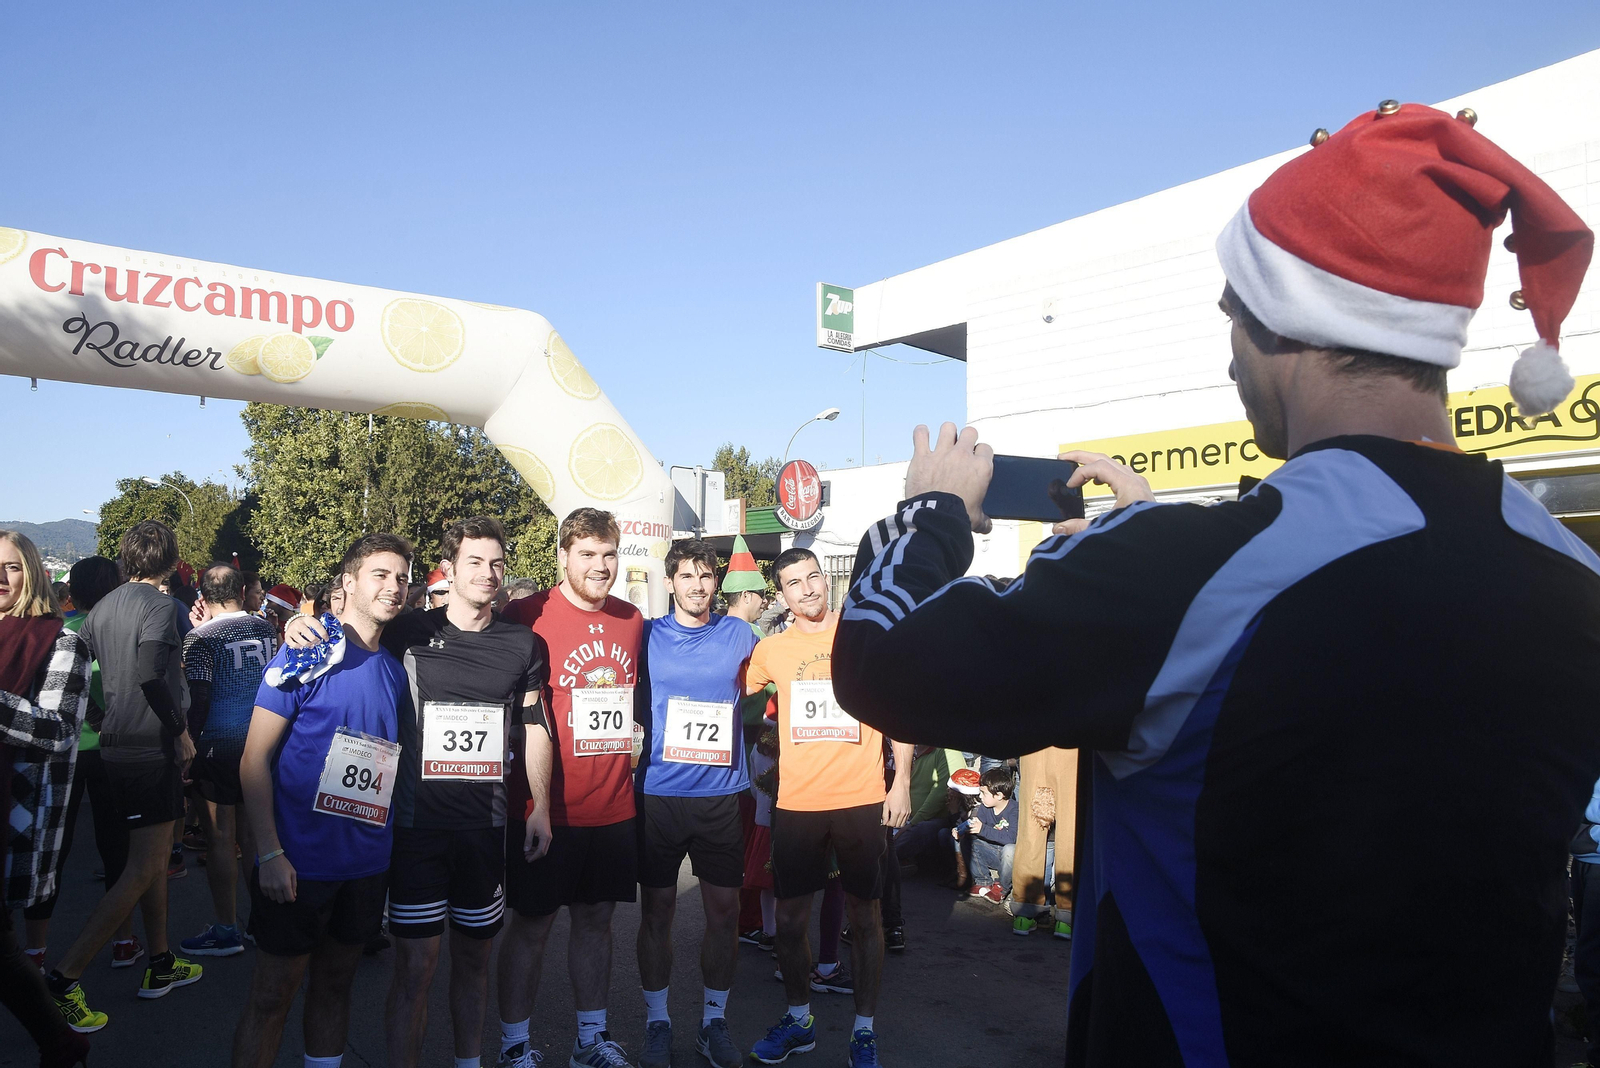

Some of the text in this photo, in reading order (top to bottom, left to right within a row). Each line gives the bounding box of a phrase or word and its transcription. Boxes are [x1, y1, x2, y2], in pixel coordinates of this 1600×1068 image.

[125, 255, 198, 273] DESDE
[28, 247, 355, 334] Cruzcampo
[62, 311, 225, 371] Radler
[827, 337, 851, 347] COMIDAS
[828, 330, 852, 341] LA ALEGRIA
[1447, 401, 1562, 438] EDRA
[780, 509, 823, 529] BAR LA ALEGRIA
[559, 640, 605, 688] SETON
[589, 710, 623, 730] 370
[443, 730, 488, 752] 337
[683, 722, 719, 742] 172
[796, 727, 846, 738] Cruzcampo
[580, 740, 625, 751] Cruzcampo
[670, 747, 720, 761] Cruzcampo
[430, 761, 490, 776] Cruzcampo
[341, 764, 383, 795] 894
[323, 795, 379, 818] Cruzcampo
